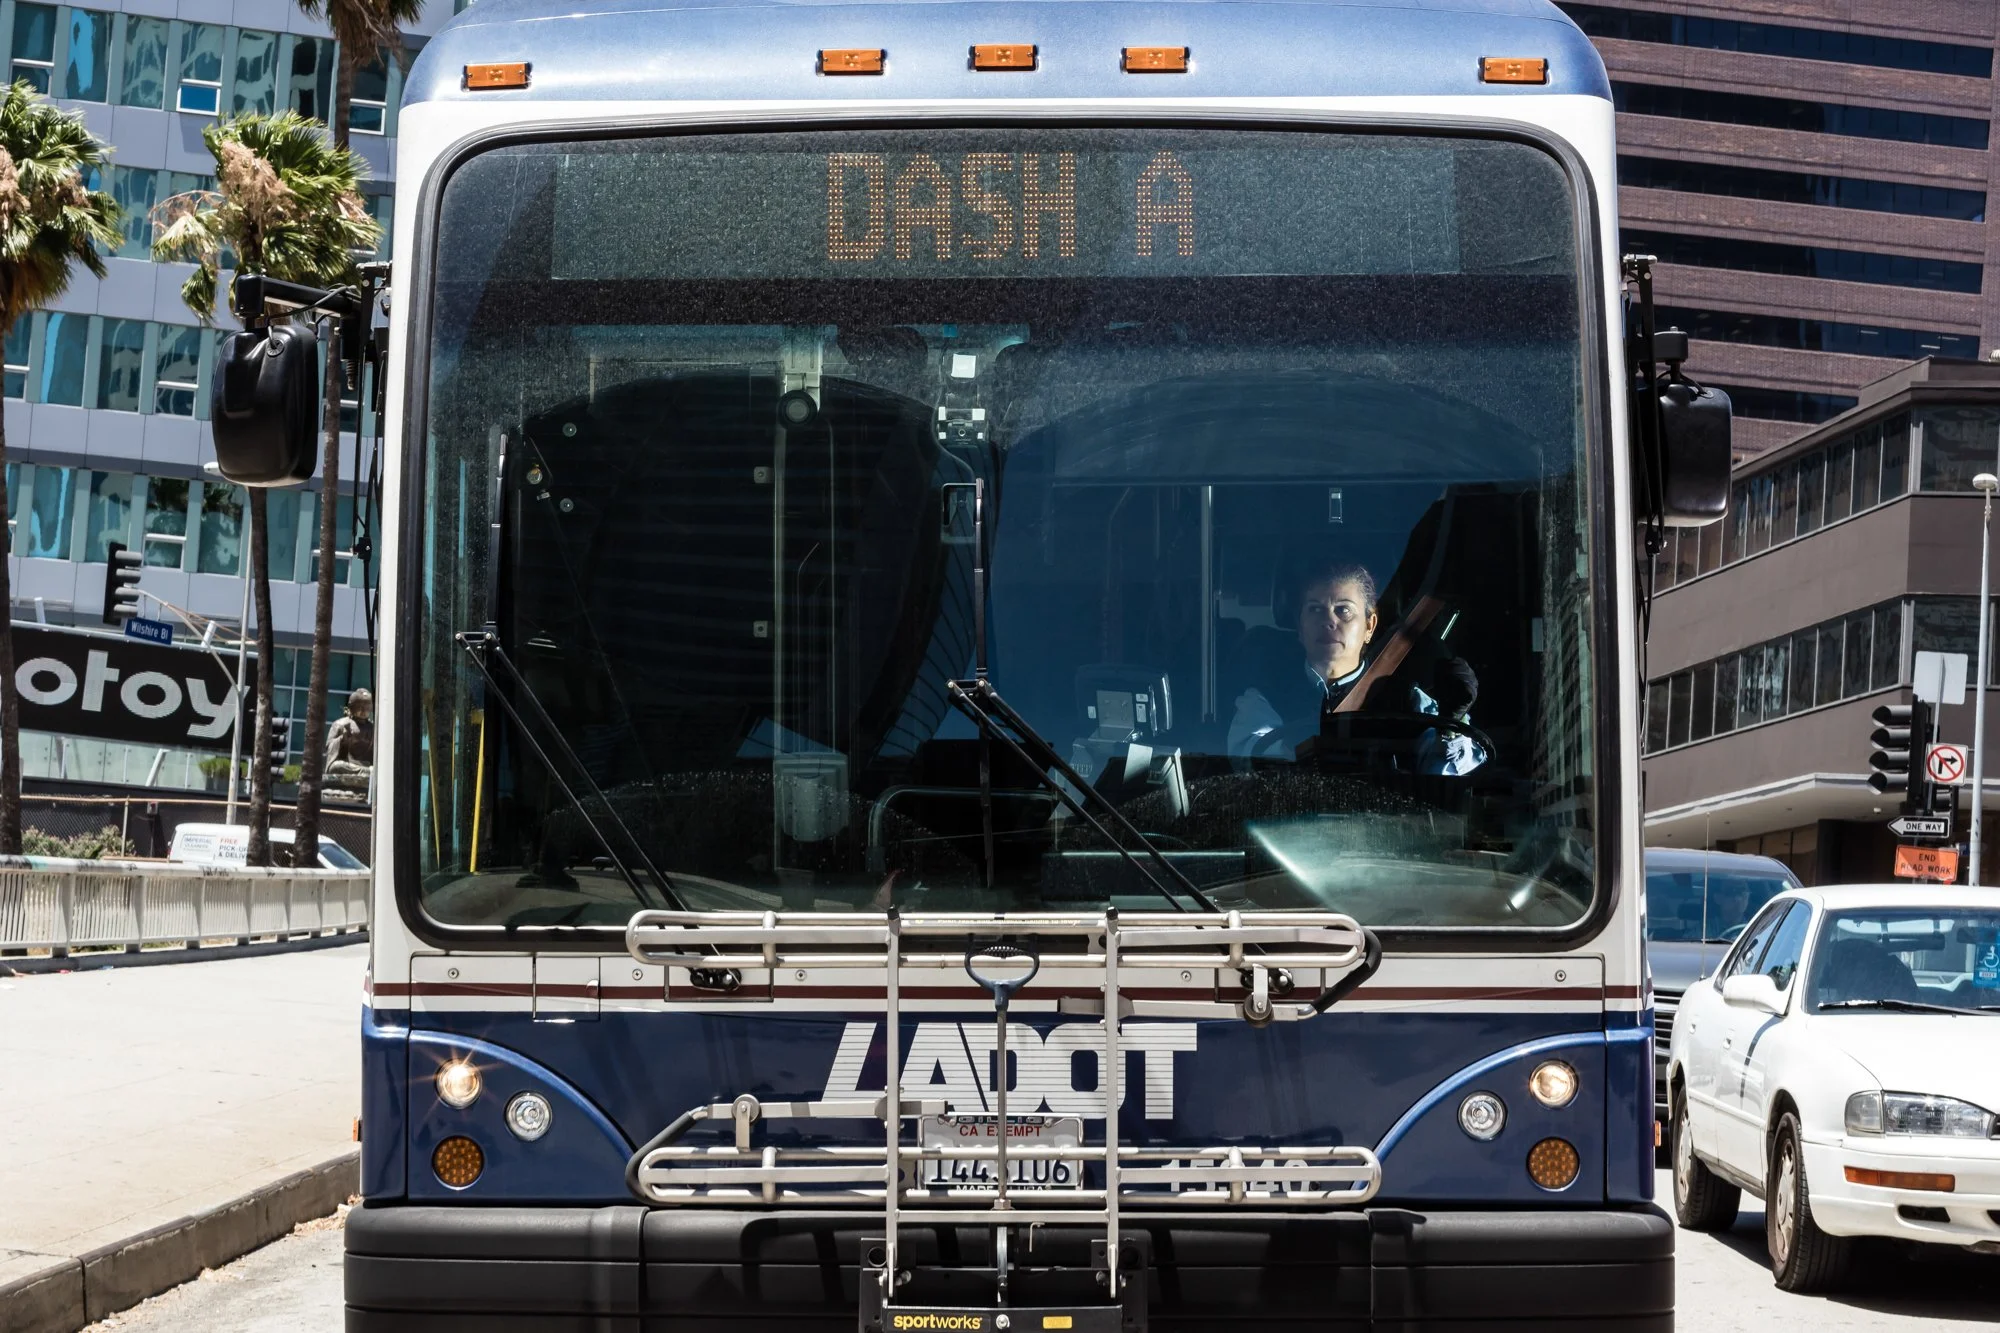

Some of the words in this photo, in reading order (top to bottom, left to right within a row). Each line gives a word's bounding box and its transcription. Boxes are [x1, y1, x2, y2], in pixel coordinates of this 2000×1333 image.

[828, 152, 1076, 260] DASH
[1137, 150, 1193, 257] A
[131, 620, 159, 638] Wilshire
[160, 627, 169, 640] Bl
[15, 649, 250, 739] otoy
[1905, 822, 1923, 831] ONE
[1925, 823, 1942, 832] WAY
[1918, 853, 1937, 863] END
[1900, 862, 1924, 872] ROAD
[1927, 865, 1952, 875] WORK
[821, 1022, 1197, 1119] LADOT
[959, 1125, 979, 1137] CA
[986, 1125, 1043, 1137] EEMPT
[931, 1146, 1070, 1183] 144106
[893, 1314, 982, 1330] sportworks
